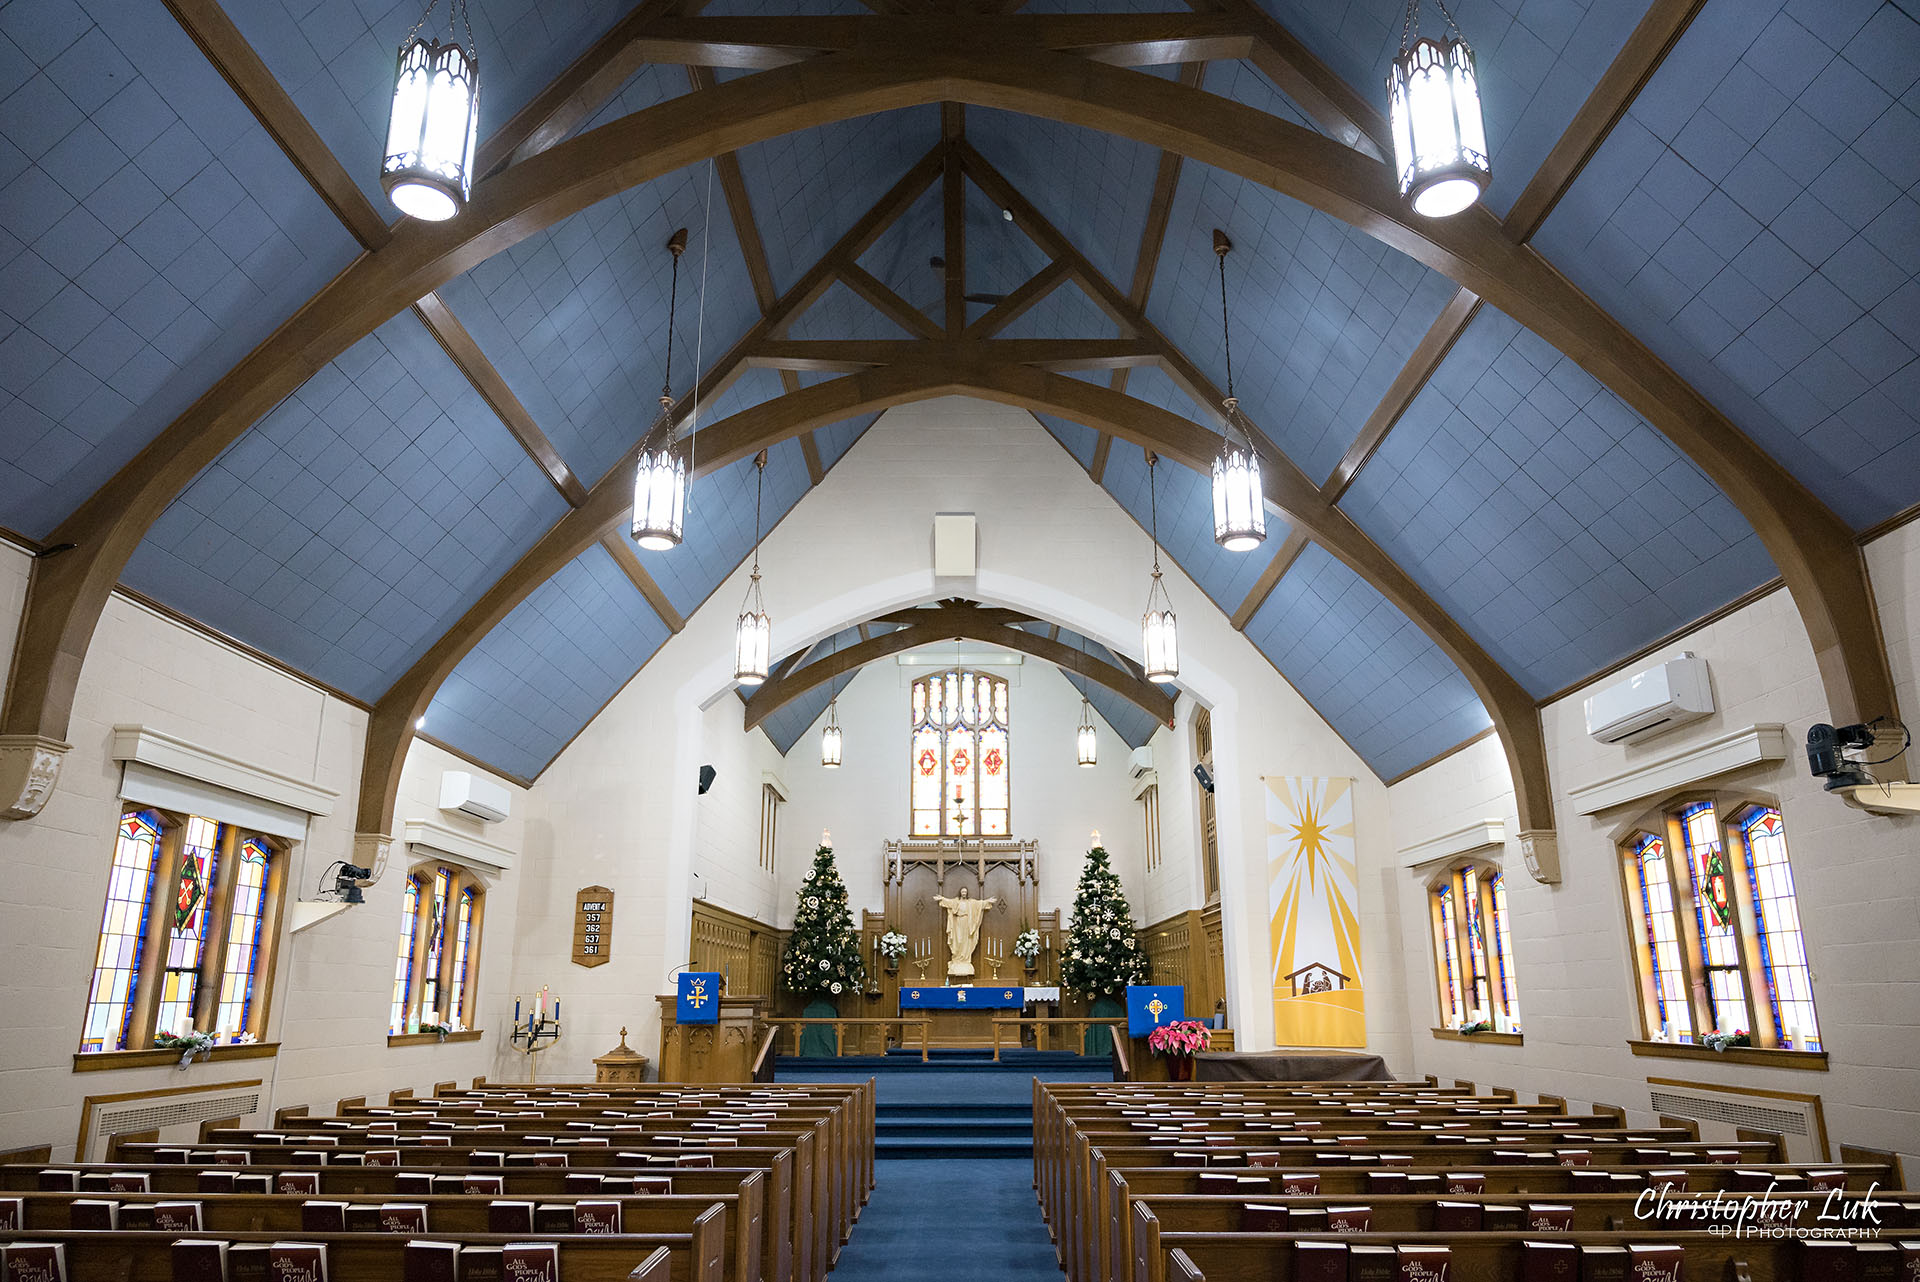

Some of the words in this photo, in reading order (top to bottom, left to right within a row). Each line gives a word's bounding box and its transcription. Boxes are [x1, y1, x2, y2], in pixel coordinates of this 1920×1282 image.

[583, 903, 601, 911] ADVENT
[601, 903, 606, 911] 4
[586, 913, 601, 922] 357
[585, 924, 600, 933] 362
[585, 934, 600, 943] 637
[584, 945, 598, 954] 361
[584, 1221, 605, 1229] PEOPLE
[281, 1267, 305, 1275] PEOPLE
[1634, 1264, 1656, 1272] GOD'S
[514, 1269, 538, 1277] PEOPLE
[1409, 1270, 1434, 1278] PEOPLE
[1642, 1269, 1666, 1278] PEOPLE
